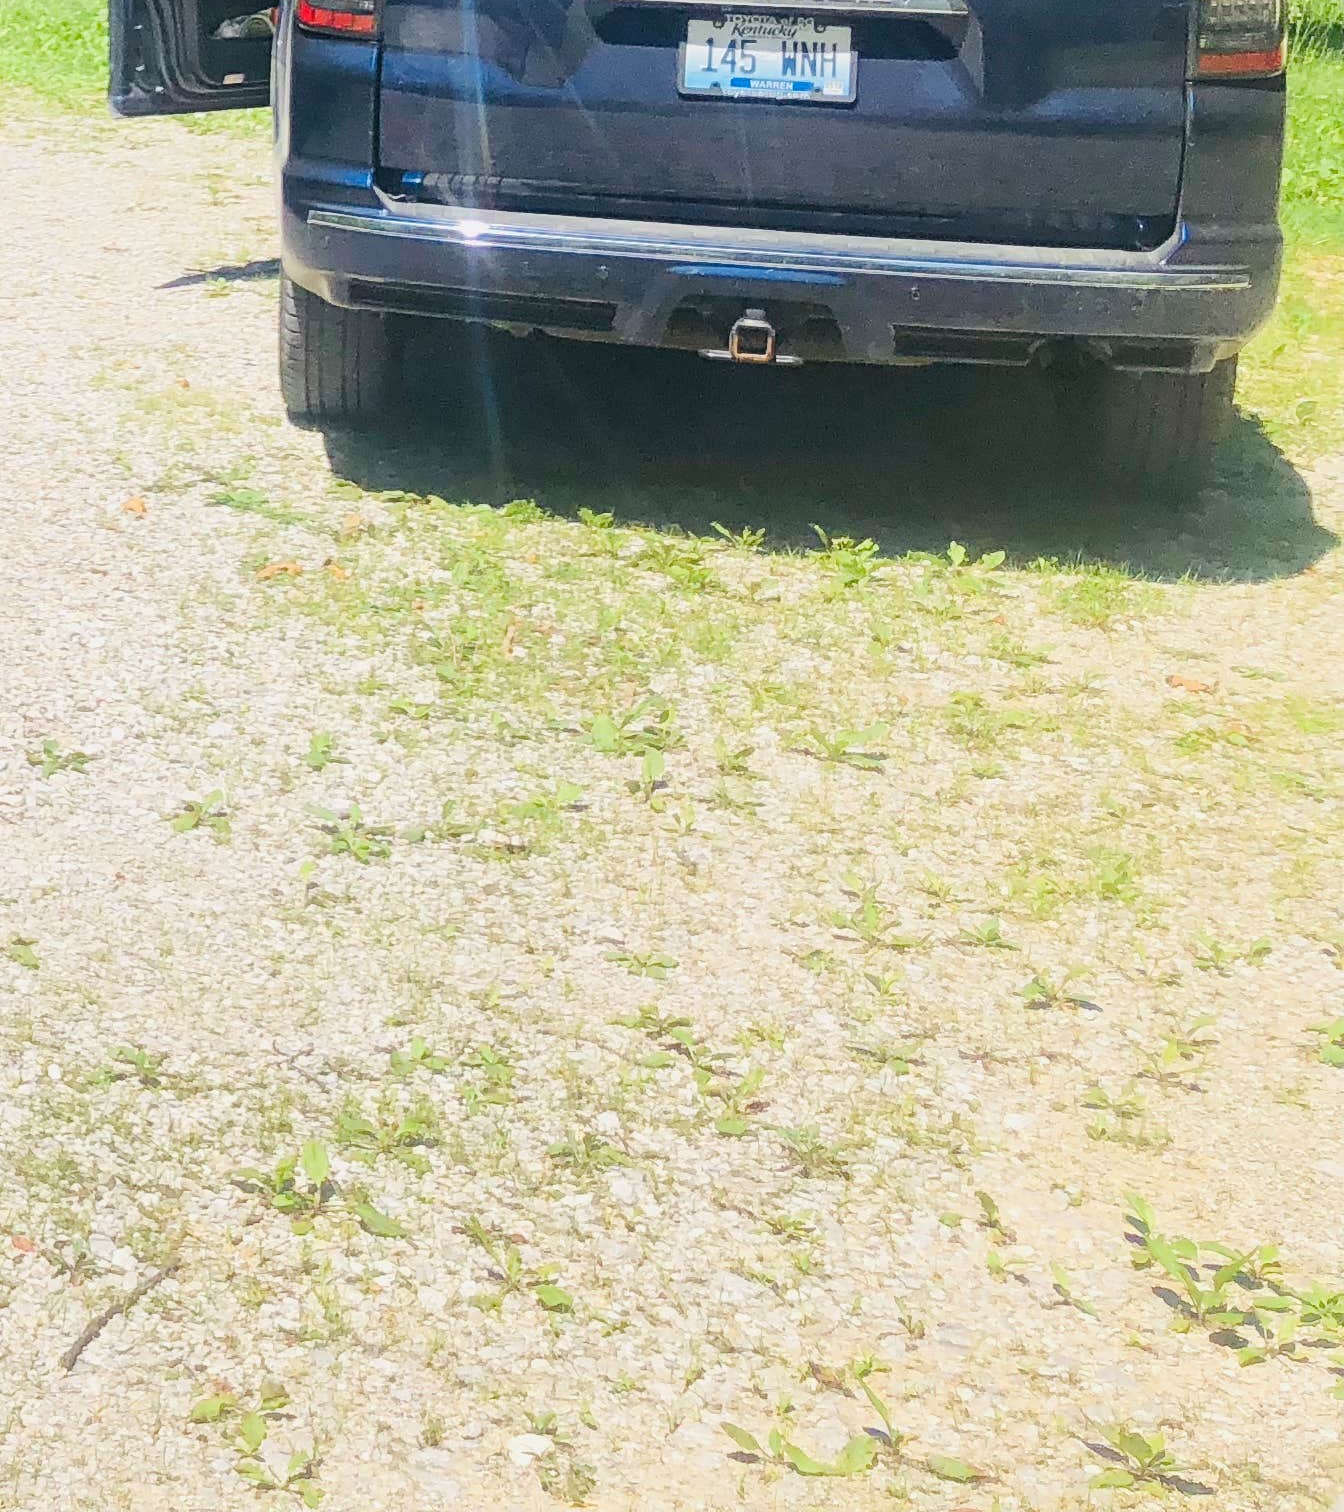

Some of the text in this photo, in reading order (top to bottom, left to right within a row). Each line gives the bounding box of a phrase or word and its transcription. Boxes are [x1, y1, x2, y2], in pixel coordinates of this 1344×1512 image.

[731, 23, 798, 39] Kentucky
[701, 37, 837, 77] 145 WNH
[749, 80, 794, 90] WARREN
